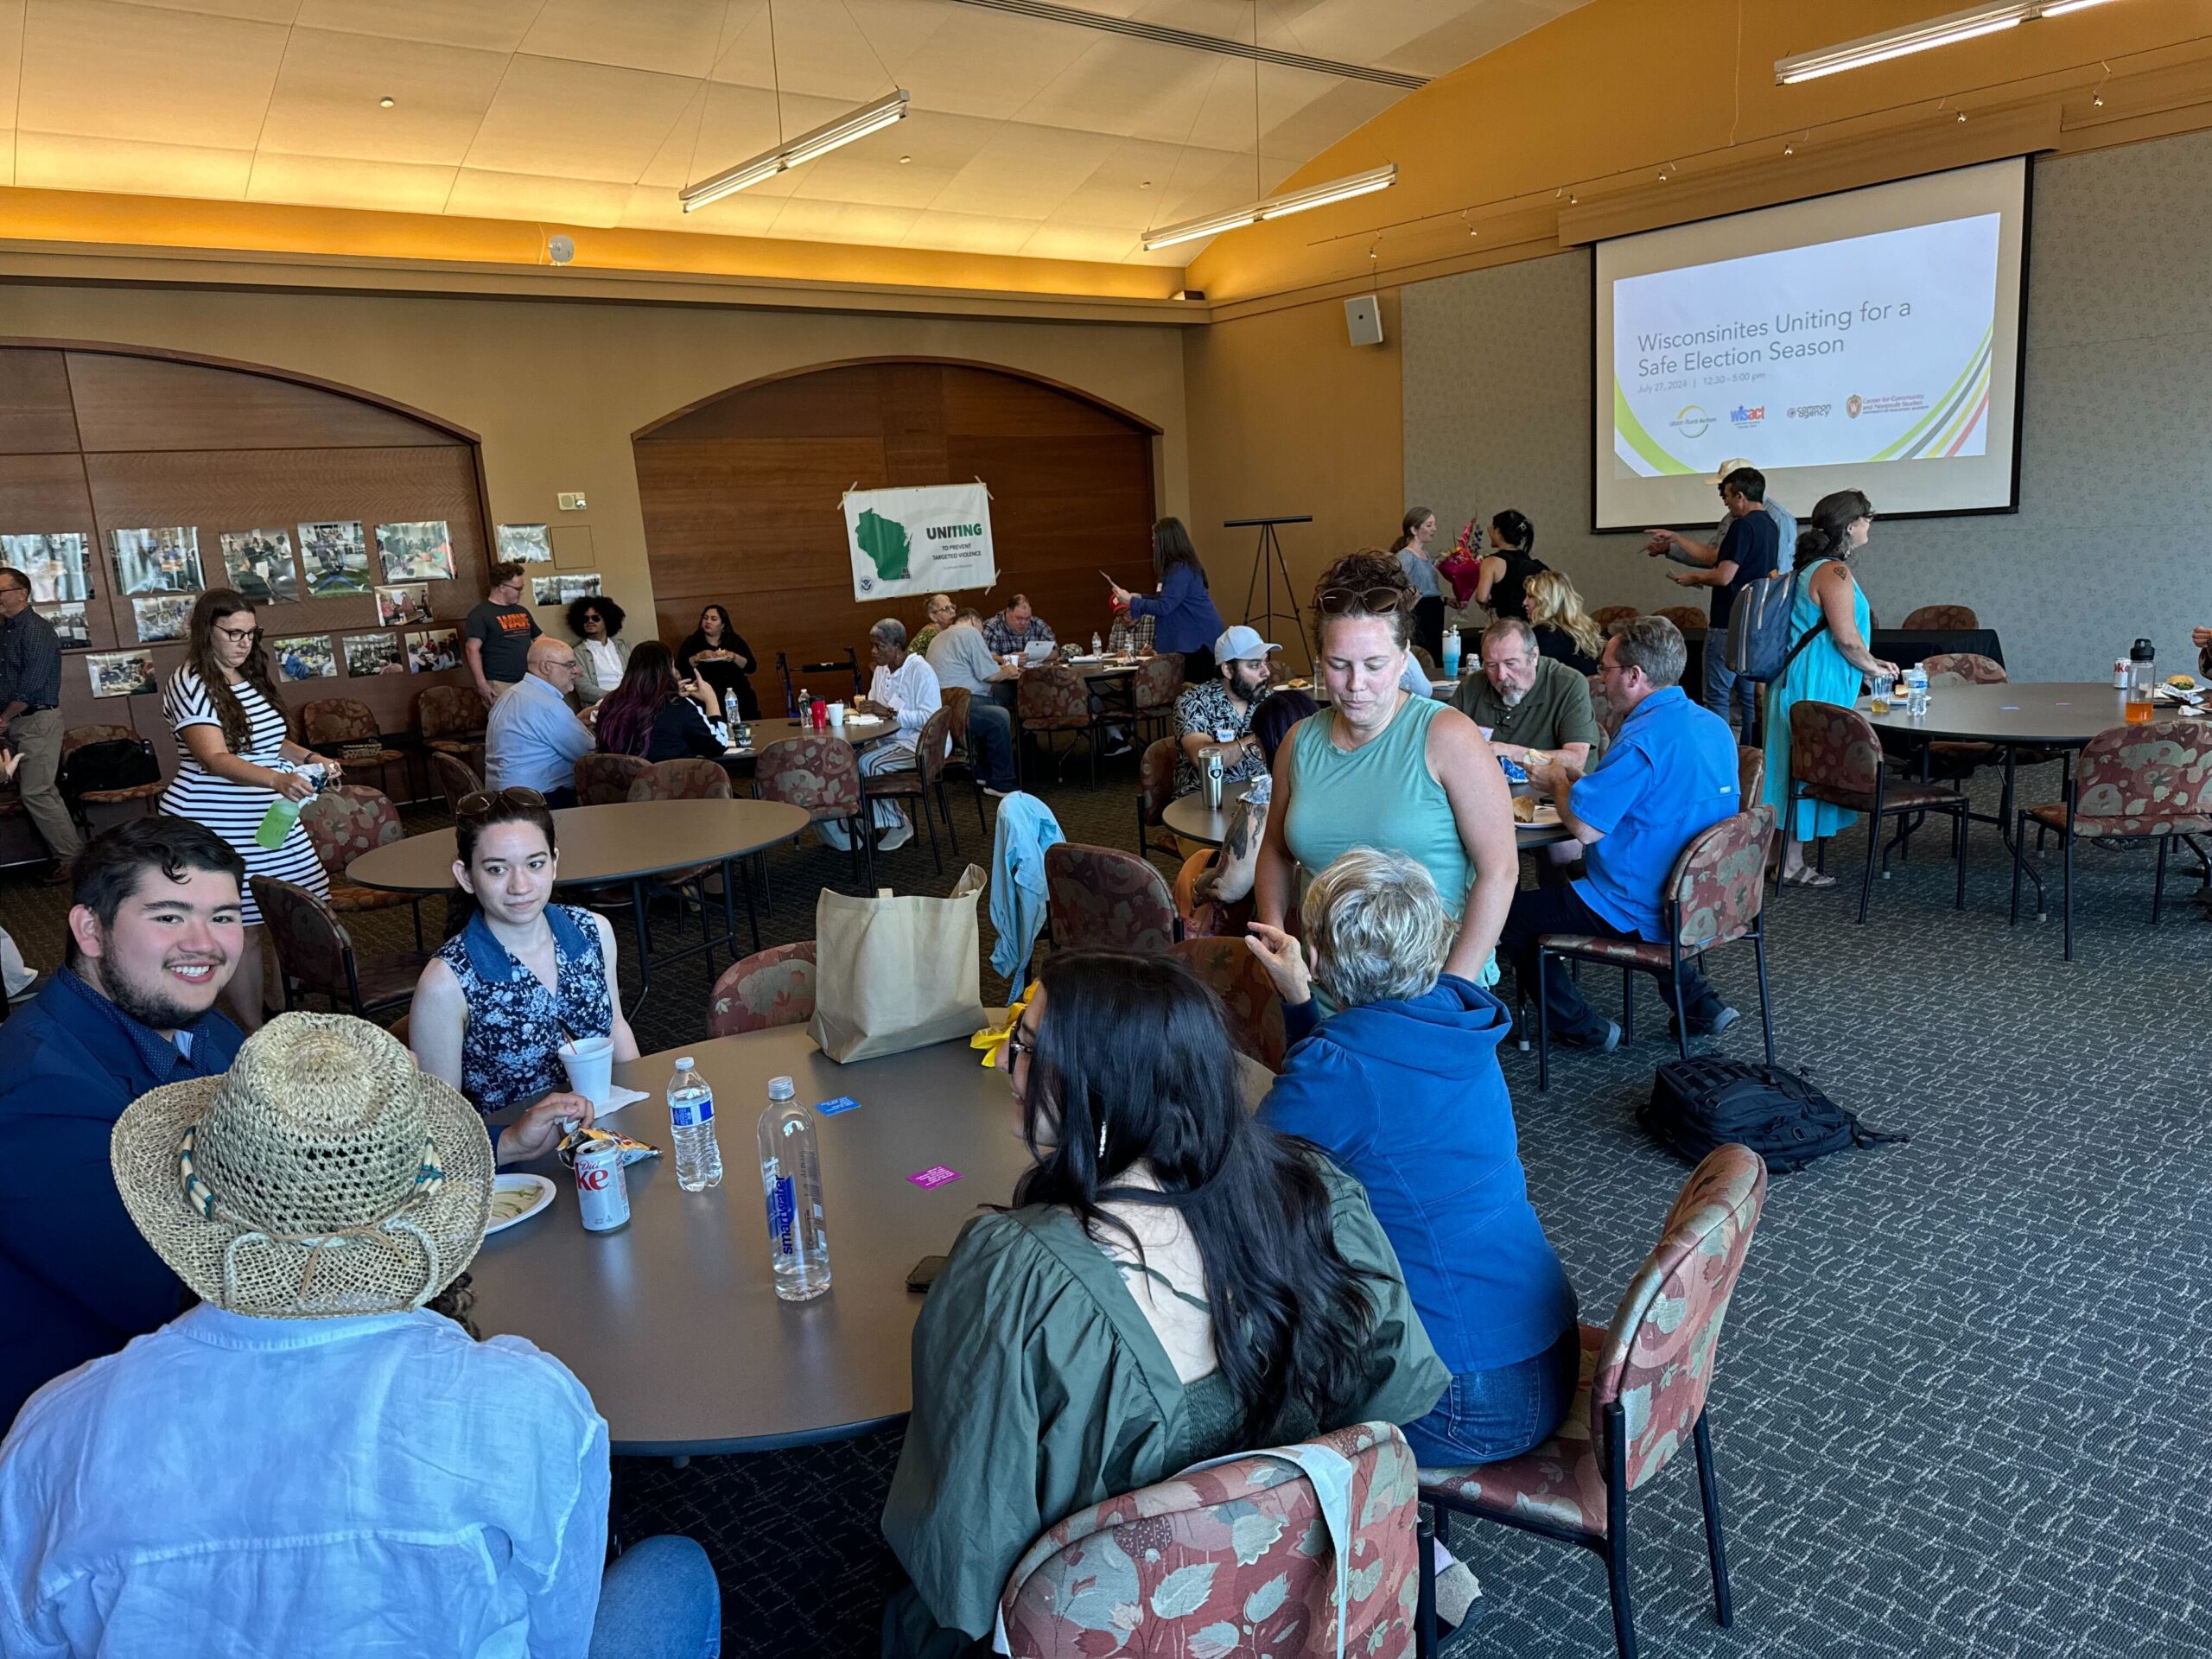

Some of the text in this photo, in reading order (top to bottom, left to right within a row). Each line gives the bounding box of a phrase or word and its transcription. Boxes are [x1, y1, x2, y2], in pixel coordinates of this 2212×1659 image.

[1637, 301, 1911, 352] Wisconsinites Uniting for a
[1638, 339, 1844, 377] Safe Election Season
[1638, 384, 1652, 394] July
[1668, 379, 1688, 390] 2024
[1703, 375, 1726, 386] 12:30
[1732, 372, 1751, 382] 5:00
[1751, 372, 1766, 382] pm
[926, 523, 982, 540] UNITING
[776, 1174, 793, 1255] smartwater
